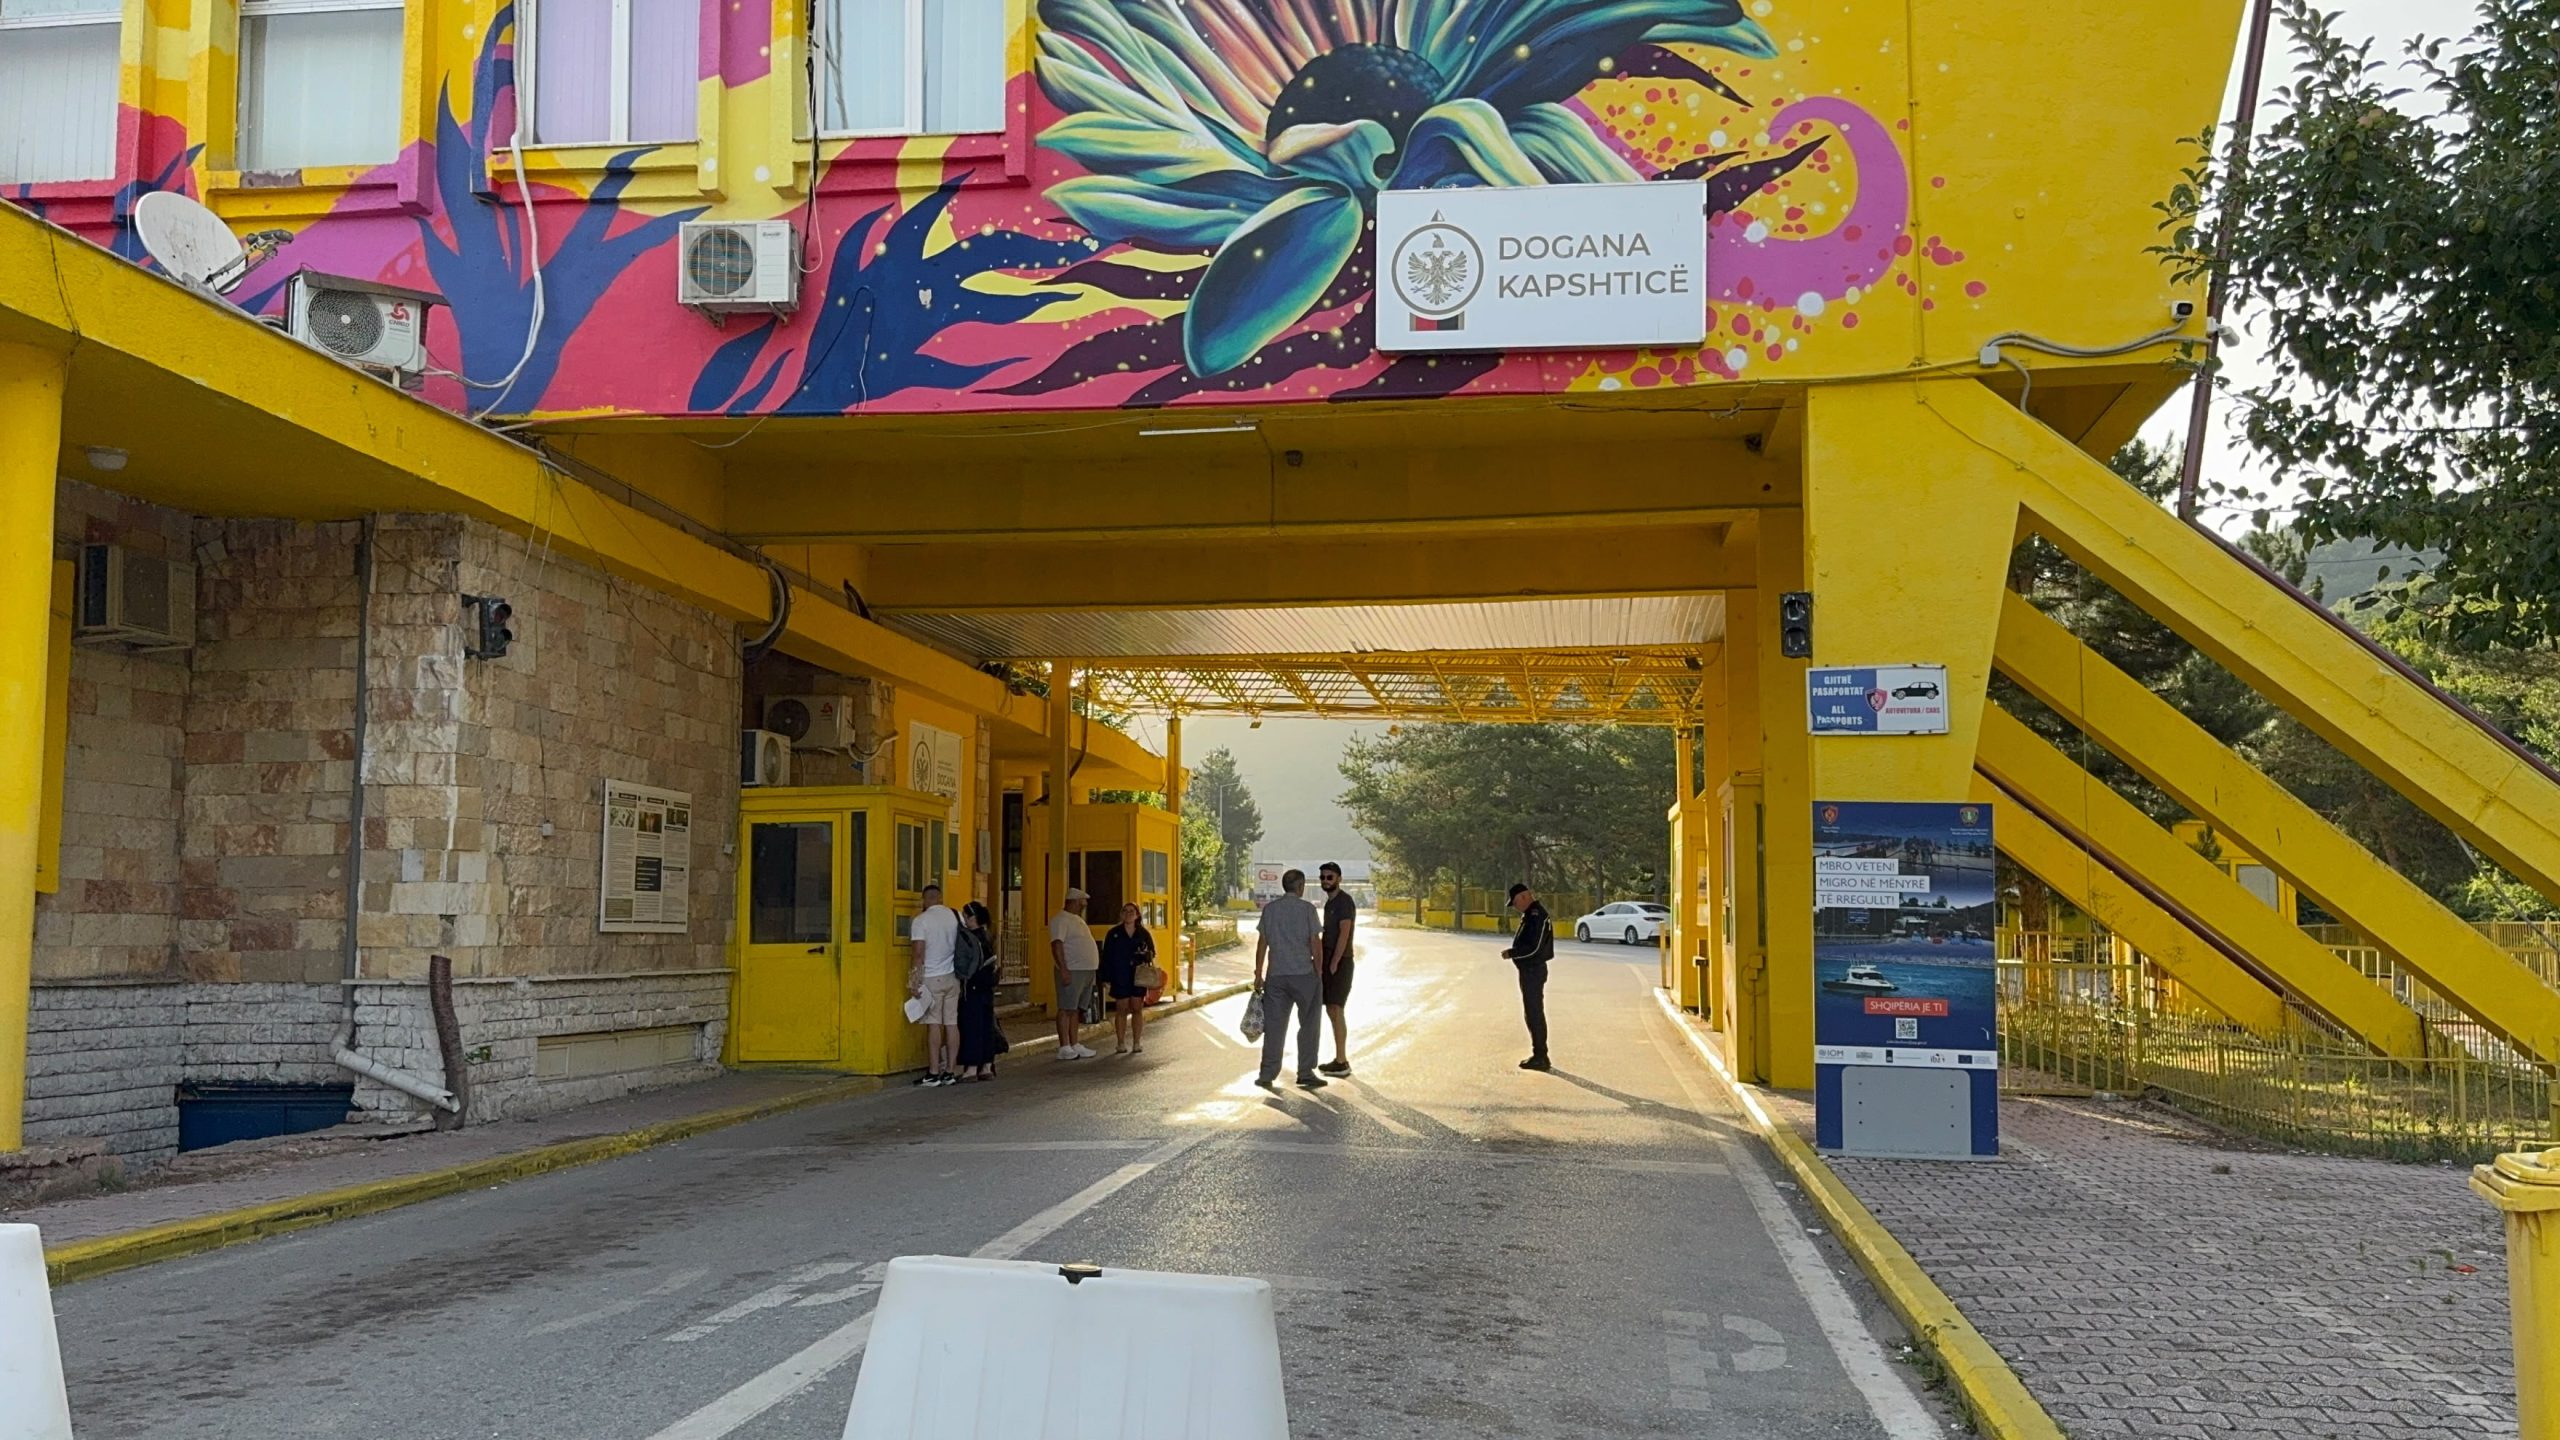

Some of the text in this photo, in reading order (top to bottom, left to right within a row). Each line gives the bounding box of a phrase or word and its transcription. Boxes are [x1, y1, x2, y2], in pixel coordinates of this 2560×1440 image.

[1499, 232, 1651, 261] DOGANA
[1498, 264, 1689, 299] KAPSHTICË
[1812, 687, 1864, 696] PASAPORTAT
[1831, 705, 1845, 714] ALL
[1819, 861, 1895, 872] MBRO VETEN!
[1819, 878, 1925, 889] MIGRO NË MËNYRË
[1820, 894, 1895, 905] TË RREGULLT!
[1932, 1002, 1942, 1012] TI
